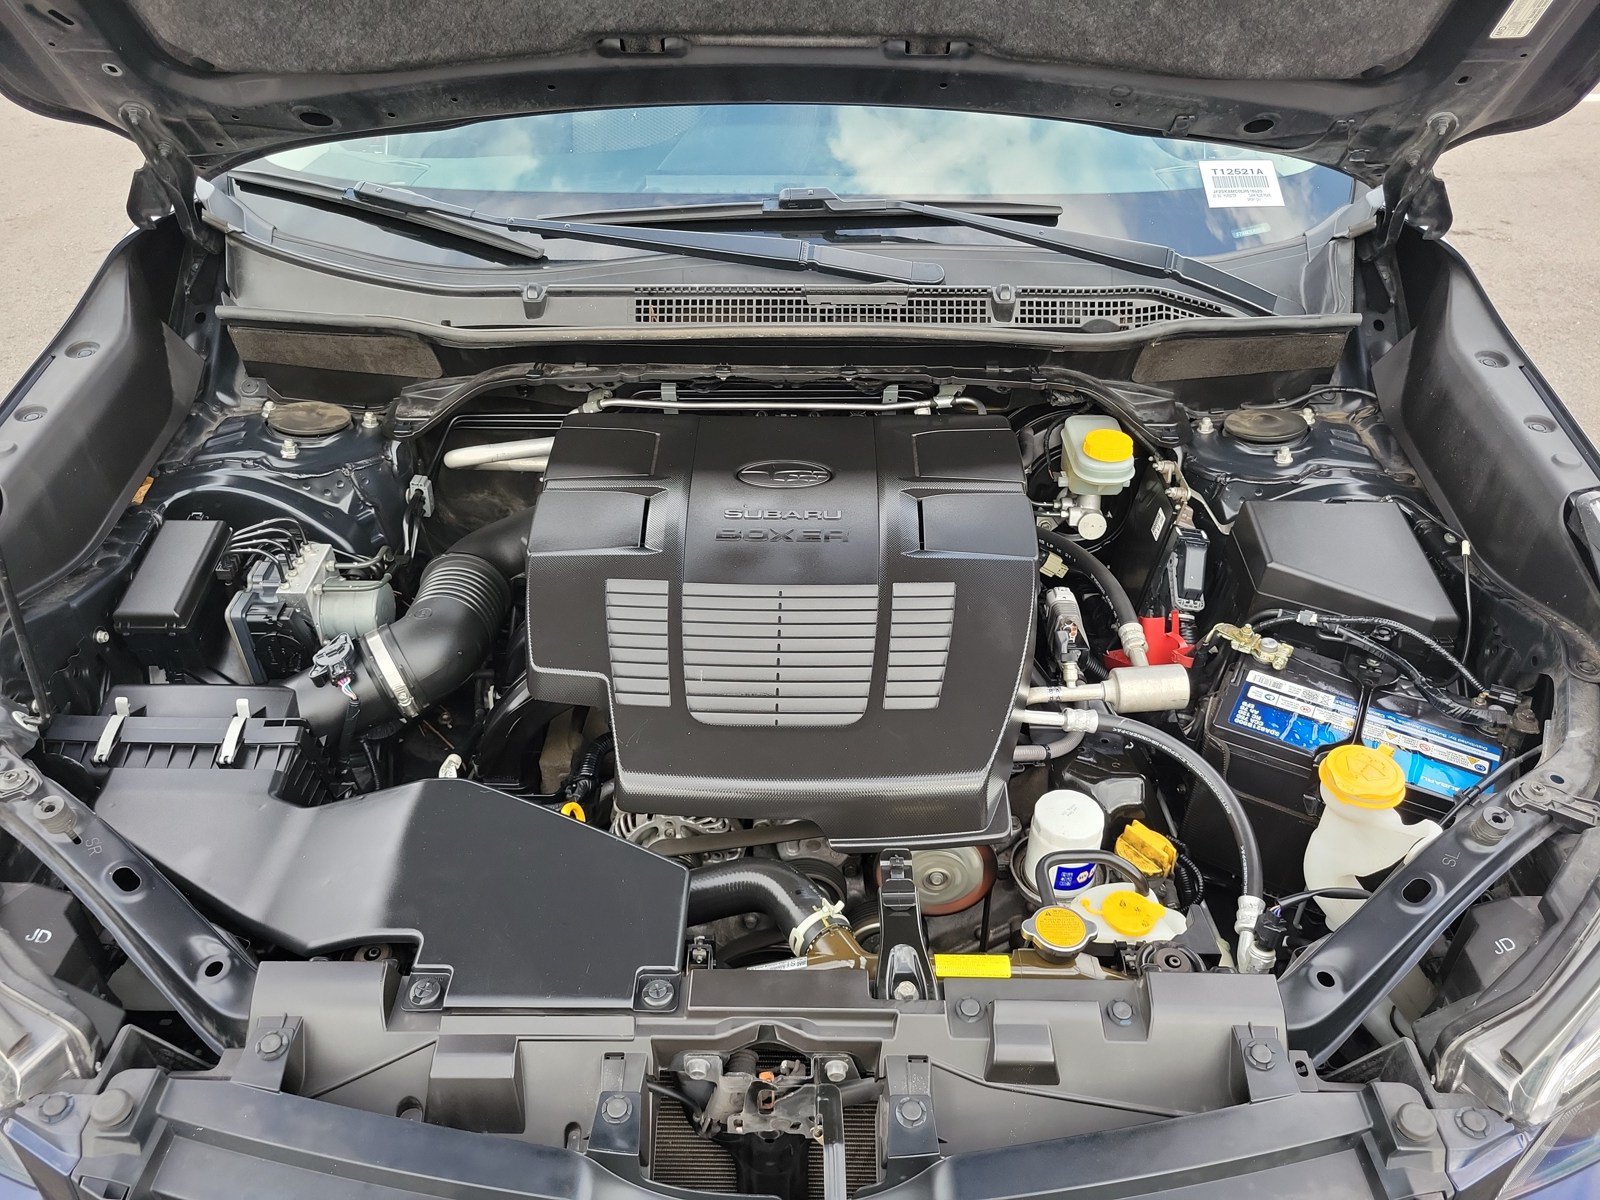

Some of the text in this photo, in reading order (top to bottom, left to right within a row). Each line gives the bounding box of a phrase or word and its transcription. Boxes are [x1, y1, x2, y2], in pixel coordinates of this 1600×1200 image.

[724, 509, 842, 521] SUBARU
[715, 528, 850, 543] BOXER
[85, 837, 103, 857] SR
[1441, 851, 1461, 868] SL
[24, 928, 53, 944] JD
[1494, 937, 1516, 955] JD
